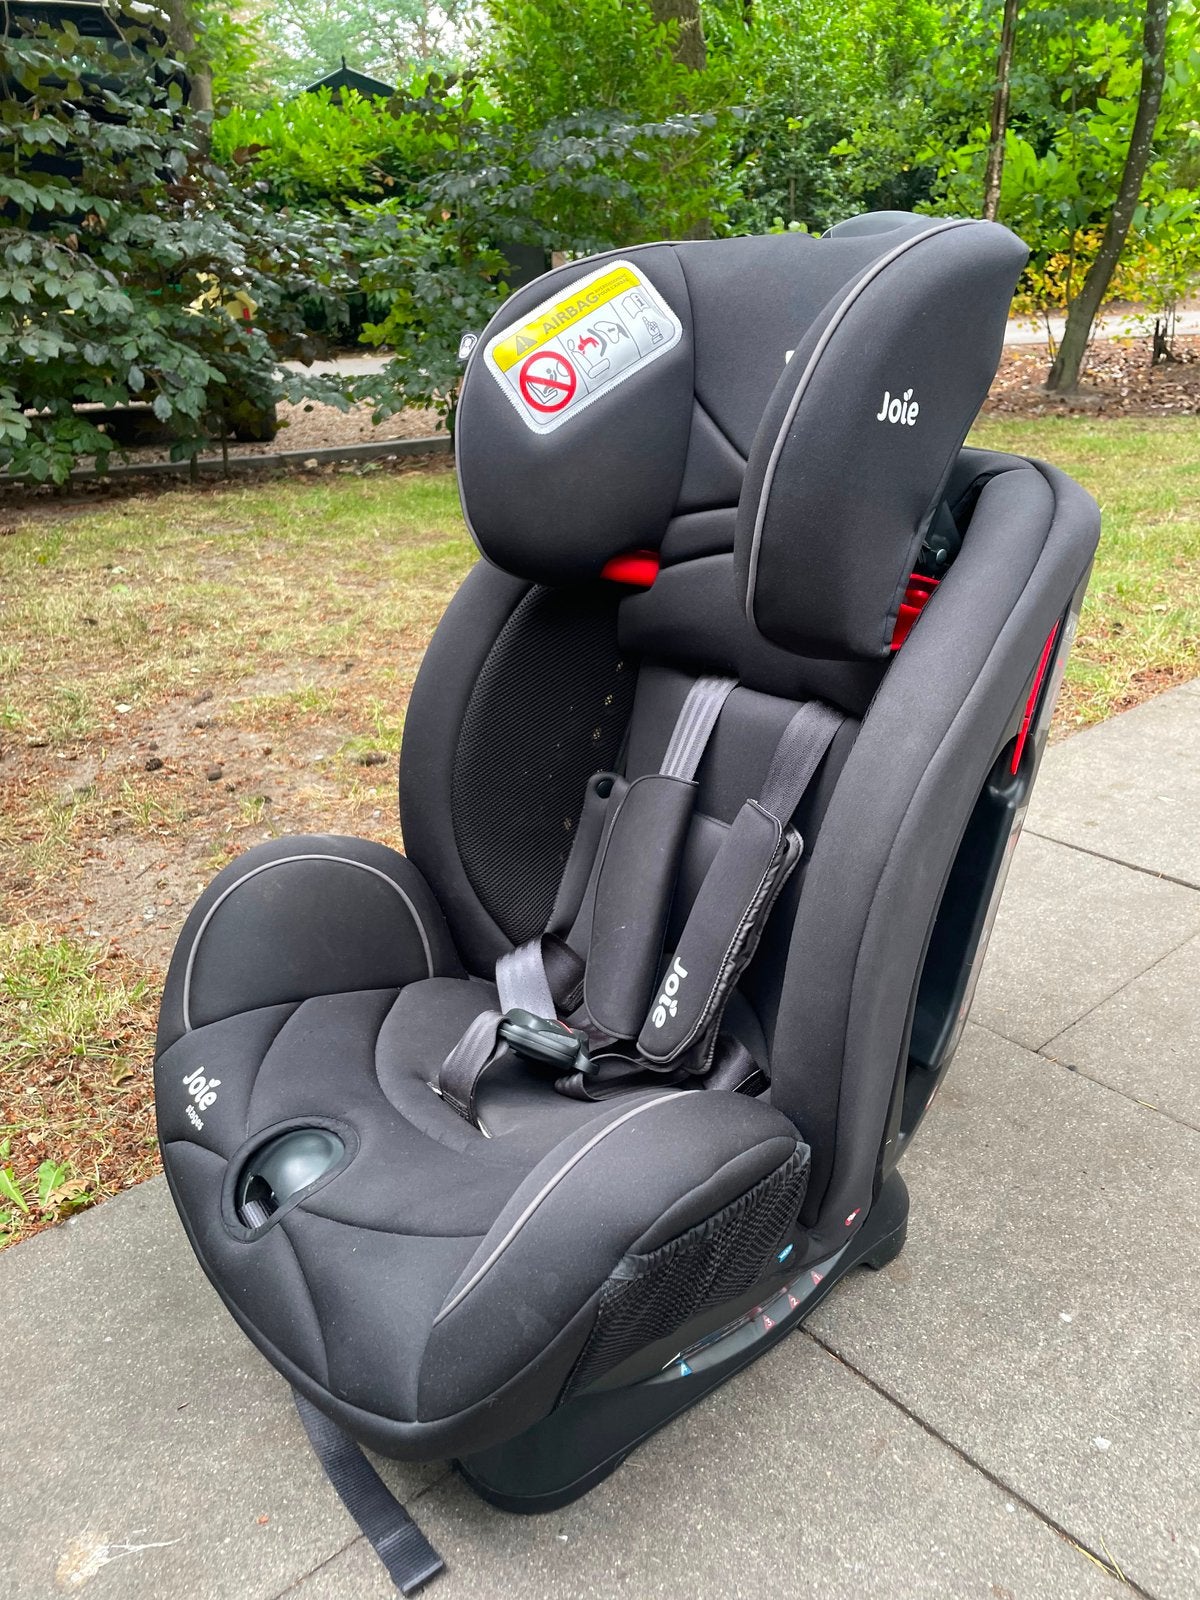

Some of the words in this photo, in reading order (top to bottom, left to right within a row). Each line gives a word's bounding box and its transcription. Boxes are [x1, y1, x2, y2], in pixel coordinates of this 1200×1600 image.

[542, 291, 599, 335] AIRBAG
[876, 388, 920, 426] Joie
[651, 956, 689, 1029] Joie
[182, 1066, 222, 1111] Joie
